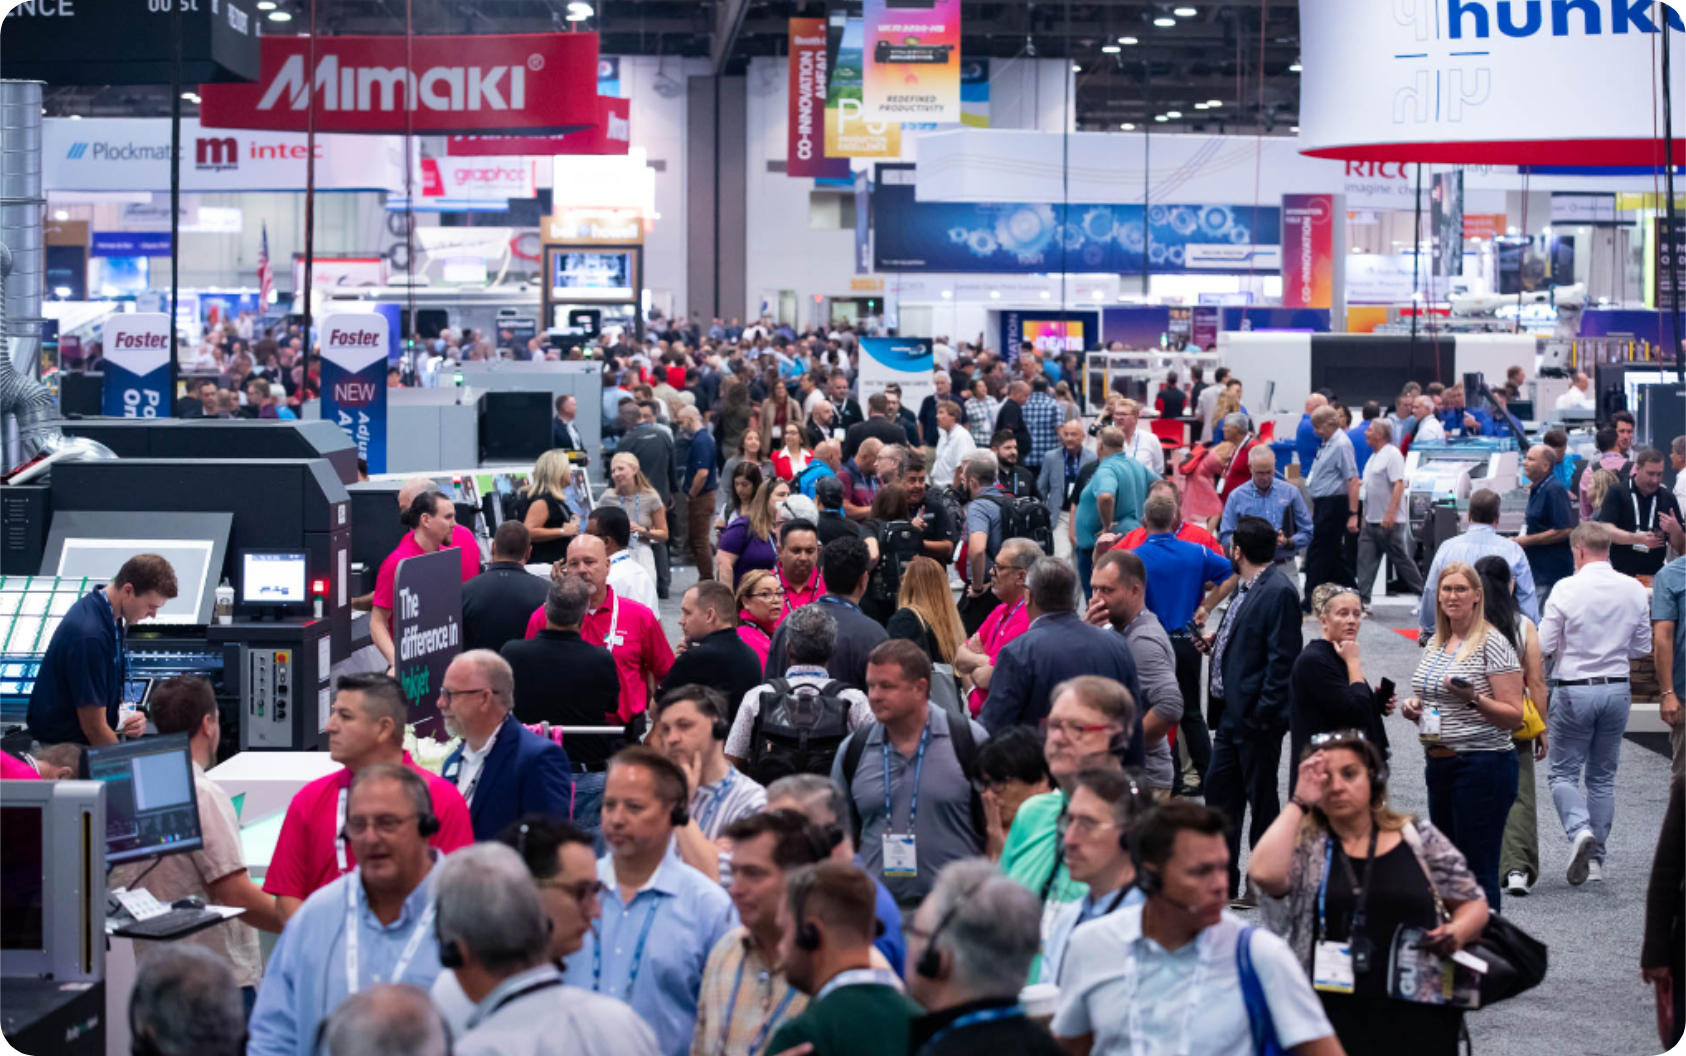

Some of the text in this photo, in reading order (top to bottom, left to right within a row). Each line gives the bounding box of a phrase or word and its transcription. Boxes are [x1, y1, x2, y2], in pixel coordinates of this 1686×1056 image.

[257, 54, 525, 111] Mimaki
[797, 51, 813, 160] CO-INNOVATION
[878, 104, 944, 112] PRODUCTIVITY
[887, 95, 937, 103] REDEFINED
[93, 142, 185, 160] Plockmatc
[115, 331, 169, 350] Foster
[329, 329, 380, 348] Foster
[334, 383, 375, 401] NEW
[399, 587, 419, 620] The
[401, 616, 458, 661] difference in
